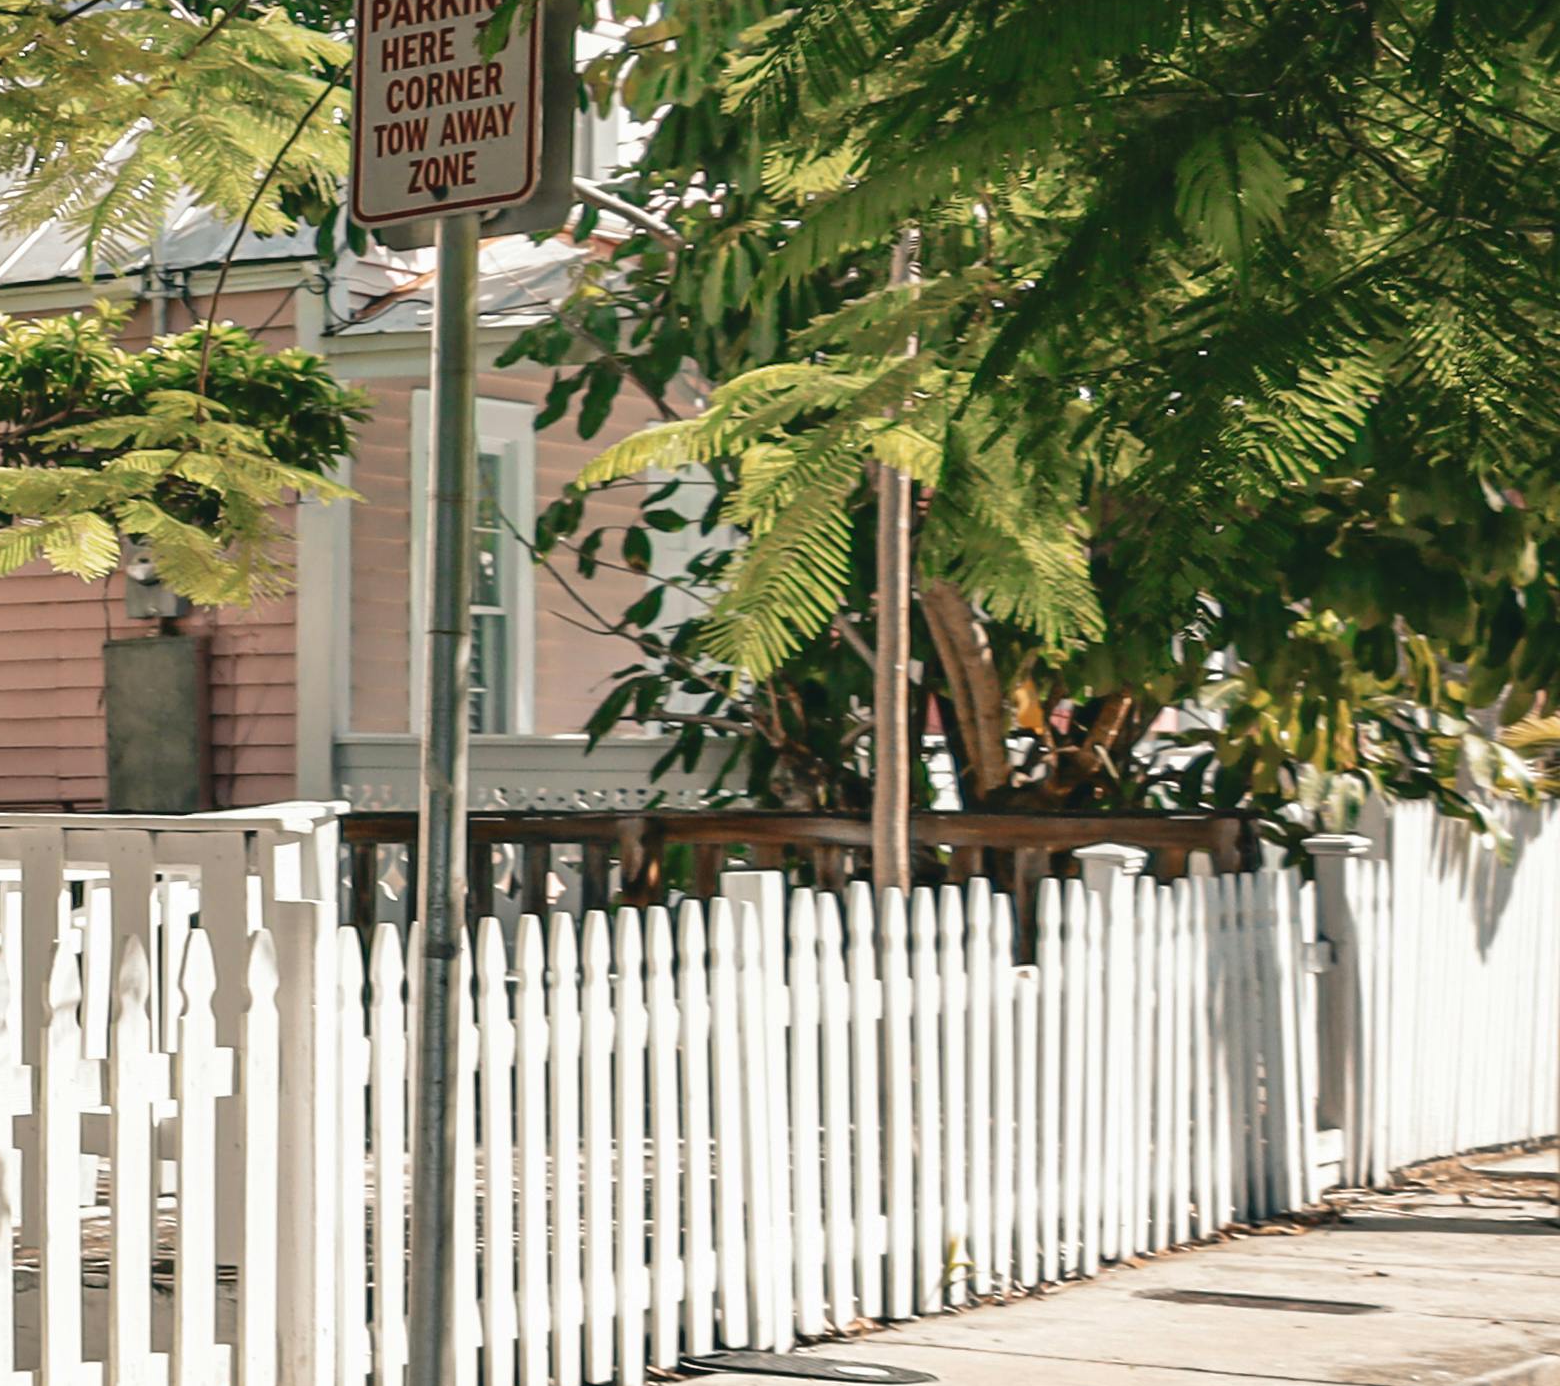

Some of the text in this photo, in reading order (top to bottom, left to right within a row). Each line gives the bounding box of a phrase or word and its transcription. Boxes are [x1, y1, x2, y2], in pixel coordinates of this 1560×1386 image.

[382, 27, 455, 72] HERE
[386, 62, 502, 114] CORNER
[374, 102, 516, 158] TOW AWAY
[408, 151, 476, 194] ZONE
